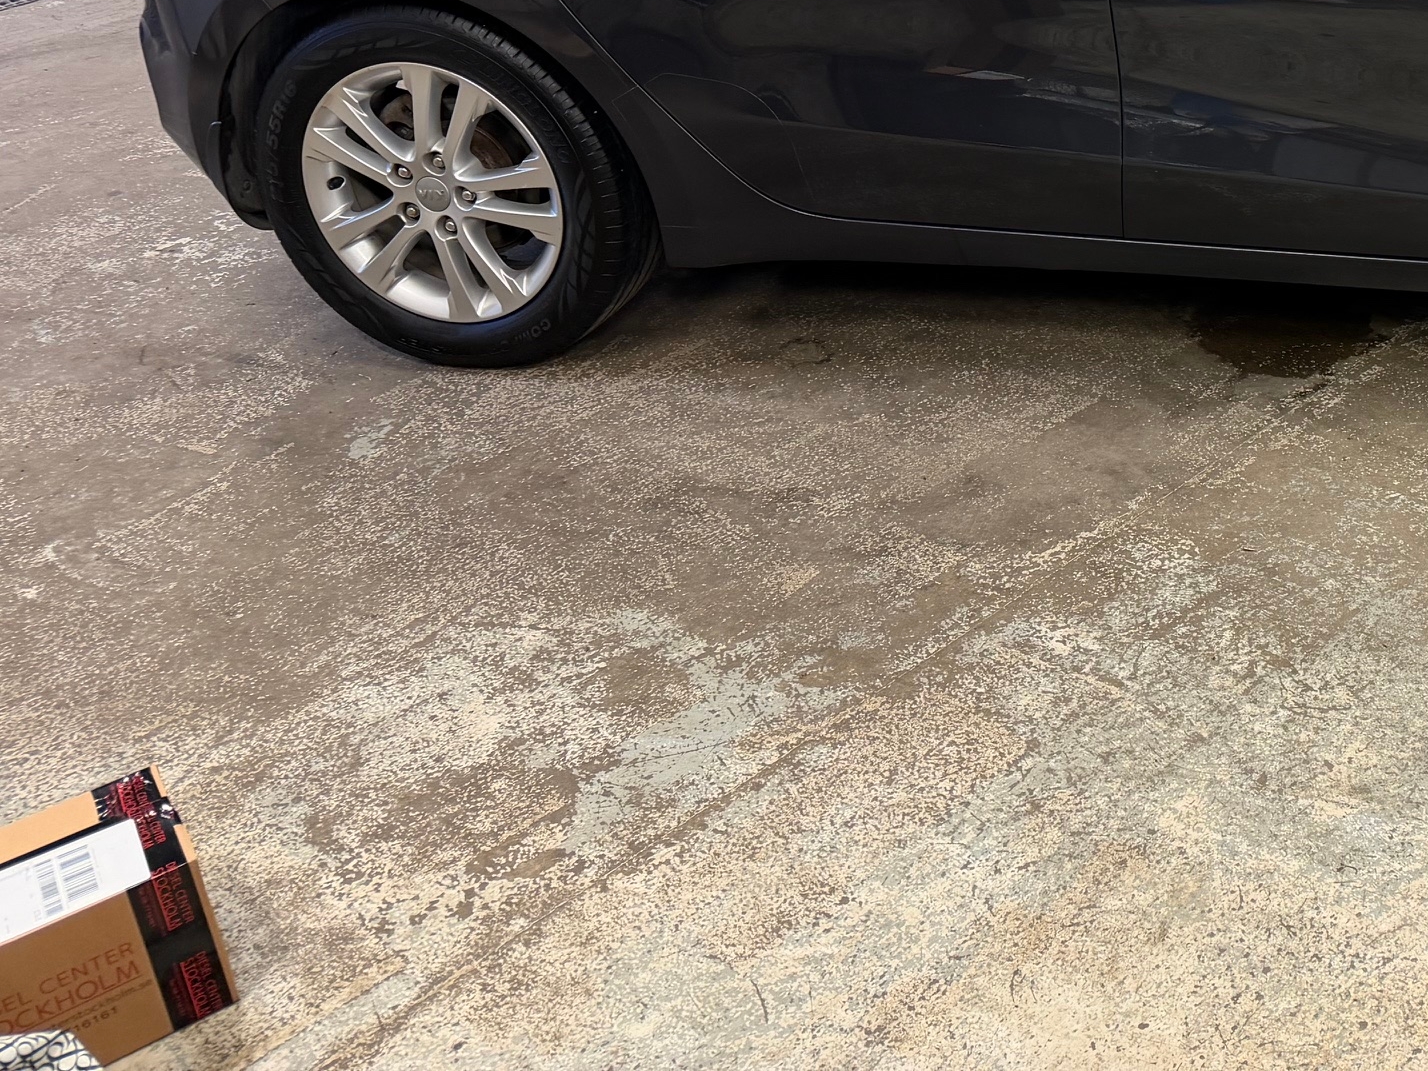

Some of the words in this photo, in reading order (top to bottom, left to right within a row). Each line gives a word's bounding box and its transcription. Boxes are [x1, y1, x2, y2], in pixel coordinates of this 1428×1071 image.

[418, 189, 448, 202] KIA
[153, 865, 183, 930] STOCKHOLM
[174, 889, 195, 924] CENTER
[39, 942, 134, 995] CENTER
[184, 957, 213, 1019] STOCKHOLM
